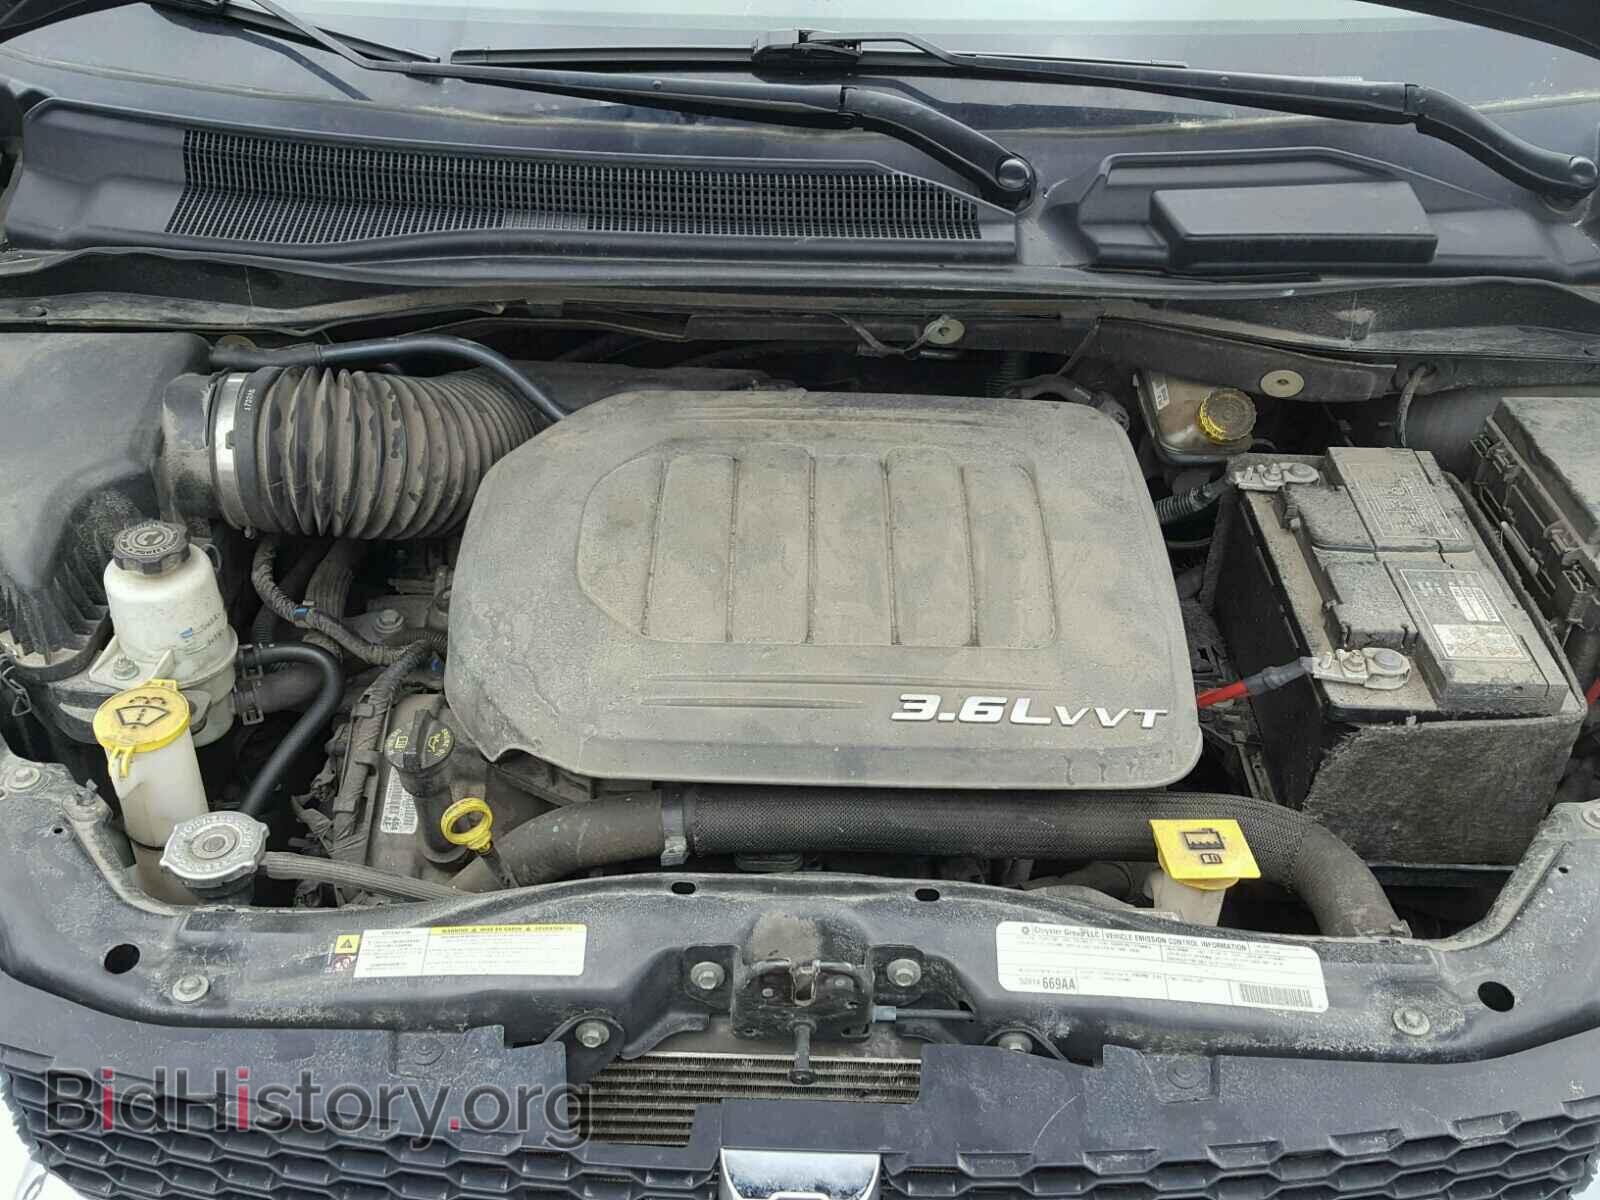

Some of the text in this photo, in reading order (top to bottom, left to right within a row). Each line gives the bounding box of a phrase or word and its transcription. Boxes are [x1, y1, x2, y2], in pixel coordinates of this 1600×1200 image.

[1105, 931, 1132, 941] VEHICLE
[1134, 934, 1167, 945] EMISSION
[1167, 937, 1199, 947] CONTROL
[1200, 940, 1247, 952] INFORMATION
[1042, 976, 1076, 990] 669AA
